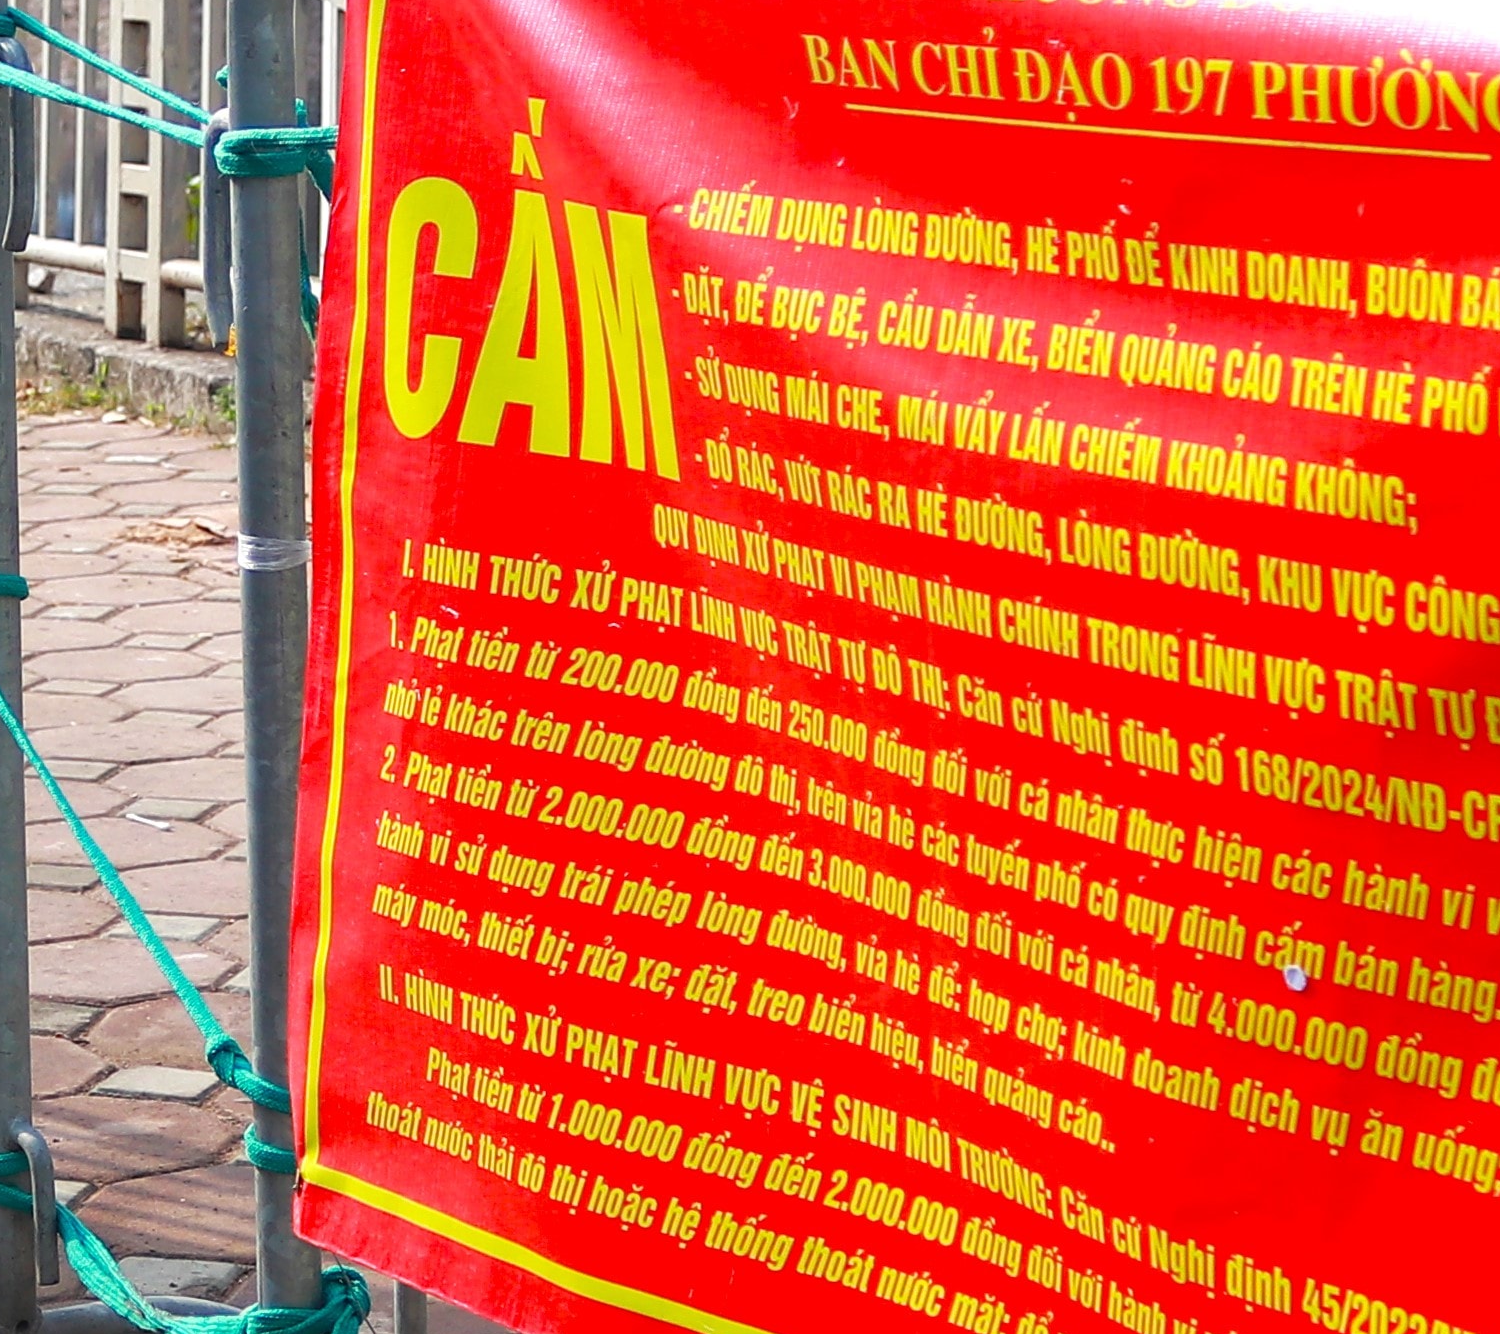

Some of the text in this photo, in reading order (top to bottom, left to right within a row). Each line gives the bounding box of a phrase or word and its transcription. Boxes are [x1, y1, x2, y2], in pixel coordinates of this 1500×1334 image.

[801, 33, 900, 93] BAN
[911, 26, 1005, 101] CHỈ
[1013, 47, 1133, 122] ĐẠO
[1150, 55, 1234, 117] 197
[384, 97, 682, 483] CẤM
[681, 264, 729, 322] ĐẶT,
[733, 271, 769, 326] ĐỂ
[768, 283, 827, 341] BỤC
[825, 285, 870, 349] BỆ,
[874, 287, 935, 351] CẦU
[933, 292, 996, 360] DẪN
[994, 315, 1040, 371] XE,
[1044, 307, 1117, 378] BIỂN
[1116, 320, 1219, 394] QUẢNG
[1219, 339, 1284, 404] CÁO
[1288, 349, 1369, 418] TRÊN
[1370, 359, 1417, 425] HÈ
[1419, 363, 1492, 435] PHỐ
[686, 180, 776, 237] CHIẾM
[773, 195, 849, 252] DỤNG
[848, 196, 920, 257] LÒNG
[922, 206, 1019, 273] ĐƯỜNG,
[1025, 217, 1060, 275] HÈ
[1065, 218, 1120, 282] PHỐ
[1123, 220, 1164, 287] ĐỂ
[1167, 241, 1239, 297] KINH
[1245, 248, 1358, 319] DOANH,
[1364, 255, 1454, 325] BUÔN
[693, 353, 723, 400] SỬ
[721, 360, 781, 415] DỤNG
[783, 369, 830, 425] MÁI
[834, 382, 890, 440] CHE,
[895, 388, 950, 446] MÁI
[1006, 400, 1067, 467] LẤN
[1066, 416, 1164, 485] CHIẾM
[1163, 431, 1289, 507] KHOẢNG
[1293, 455, 1418, 534] KHÔNG;
[703, 426, 734, 483] ĐỔ
[734, 444, 785, 499] RÁC,
[782, 453, 823, 507] VỨT
[825, 463, 873, 520] RÁC
[876, 479, 912, 529] RA
[915, 482, 948, 538] HÈ
[952, 492, 1052, 564] ĐƯỜNG,
[1057, 507, 1132, 576] LÒNG
[1136, 527, 1250, 605] ĐƯỜNG,
[1257, 552, 1322, 613] KHU
[1330, 565, 1395, 634] VỰC
[652, 501, 690, 549] QUY
[691, 512, 740, 566] ĐỊNH
[739, 518, 770, 575] XỬ
[771, 535, 825, 591] PHẠT
[827, 551, 854, 599] VI
[853, 559, 922, 622] PHẠM
[923, 574, 993, 638] HÀNH
[996, 594, 1080, 659] CHÍNH
[1085, 614, 1180, 683] TRONG
[1186, 630, 1257, 699] LĨNH
[1263, 652, 1326, 720] VỰC
[1334, 666, 1417, 738] TRẬT
[1426, 686, 1476, 750] TỰ
[378, 742, 396, 783] 2.
[401, 748, 453, 803] Phạt
[452, 762, 503, 811] tiền
[503, 777, 539, 818] từ
[536, 783, 686, 849] 2.000.000
[684, 814, 757, 871] đồng
[758, 830, 805, 881] đến
[806, 846, 912, 921] 3.000.000
[915, 886, 970, 948] đồng
[974, 909, 1013, 959] đối
[1016, 928, 1055, 975] với
[1058, 944, 1090, 989] cá
[1093, 956, 1161, 1021] nhân,
[1169, 979, 1203, 1028] từ
[1206, 989, 1368, 1070] 4.000.000
[1374, 1030, 1463, 1099] đồng
[365, 1089, 422, 1141] thoát
[422, 1115, 474, 1162] nước
[476, 1131, 515, 1180] thải
[516, 1150, 546, 1193] đô
[547, 1162, 588, 1215] thị
[586, 1173, 658, 1231] hoặc
[659, 1195, 702, 1249] hệ
[703, 1208, 795, 1272] thống
[795, 1234, 875, 1293] thoát
[874, 1264, 946, 1317] nước
